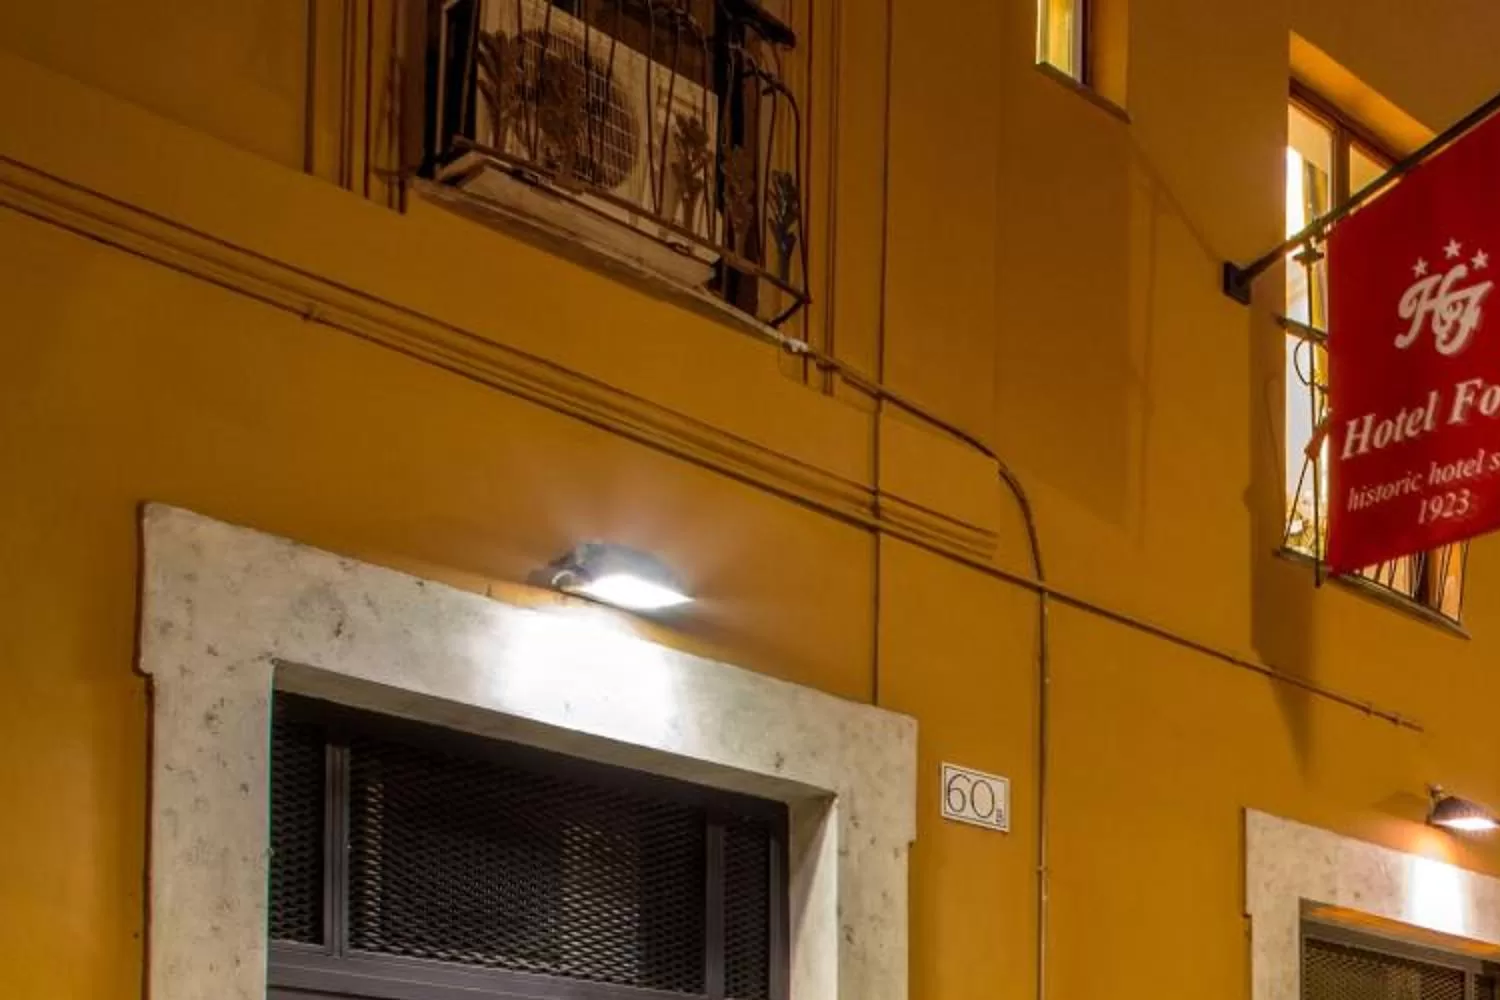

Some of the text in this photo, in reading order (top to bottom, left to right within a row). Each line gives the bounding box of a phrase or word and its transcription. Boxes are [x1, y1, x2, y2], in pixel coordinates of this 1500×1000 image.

[1341, 390, 1438, 460] Hotel
[1347, 469, 1422, 512] historic
[1429, 448, 1484, 484] hotel
[1418, 489, 1471, 524] 1923
